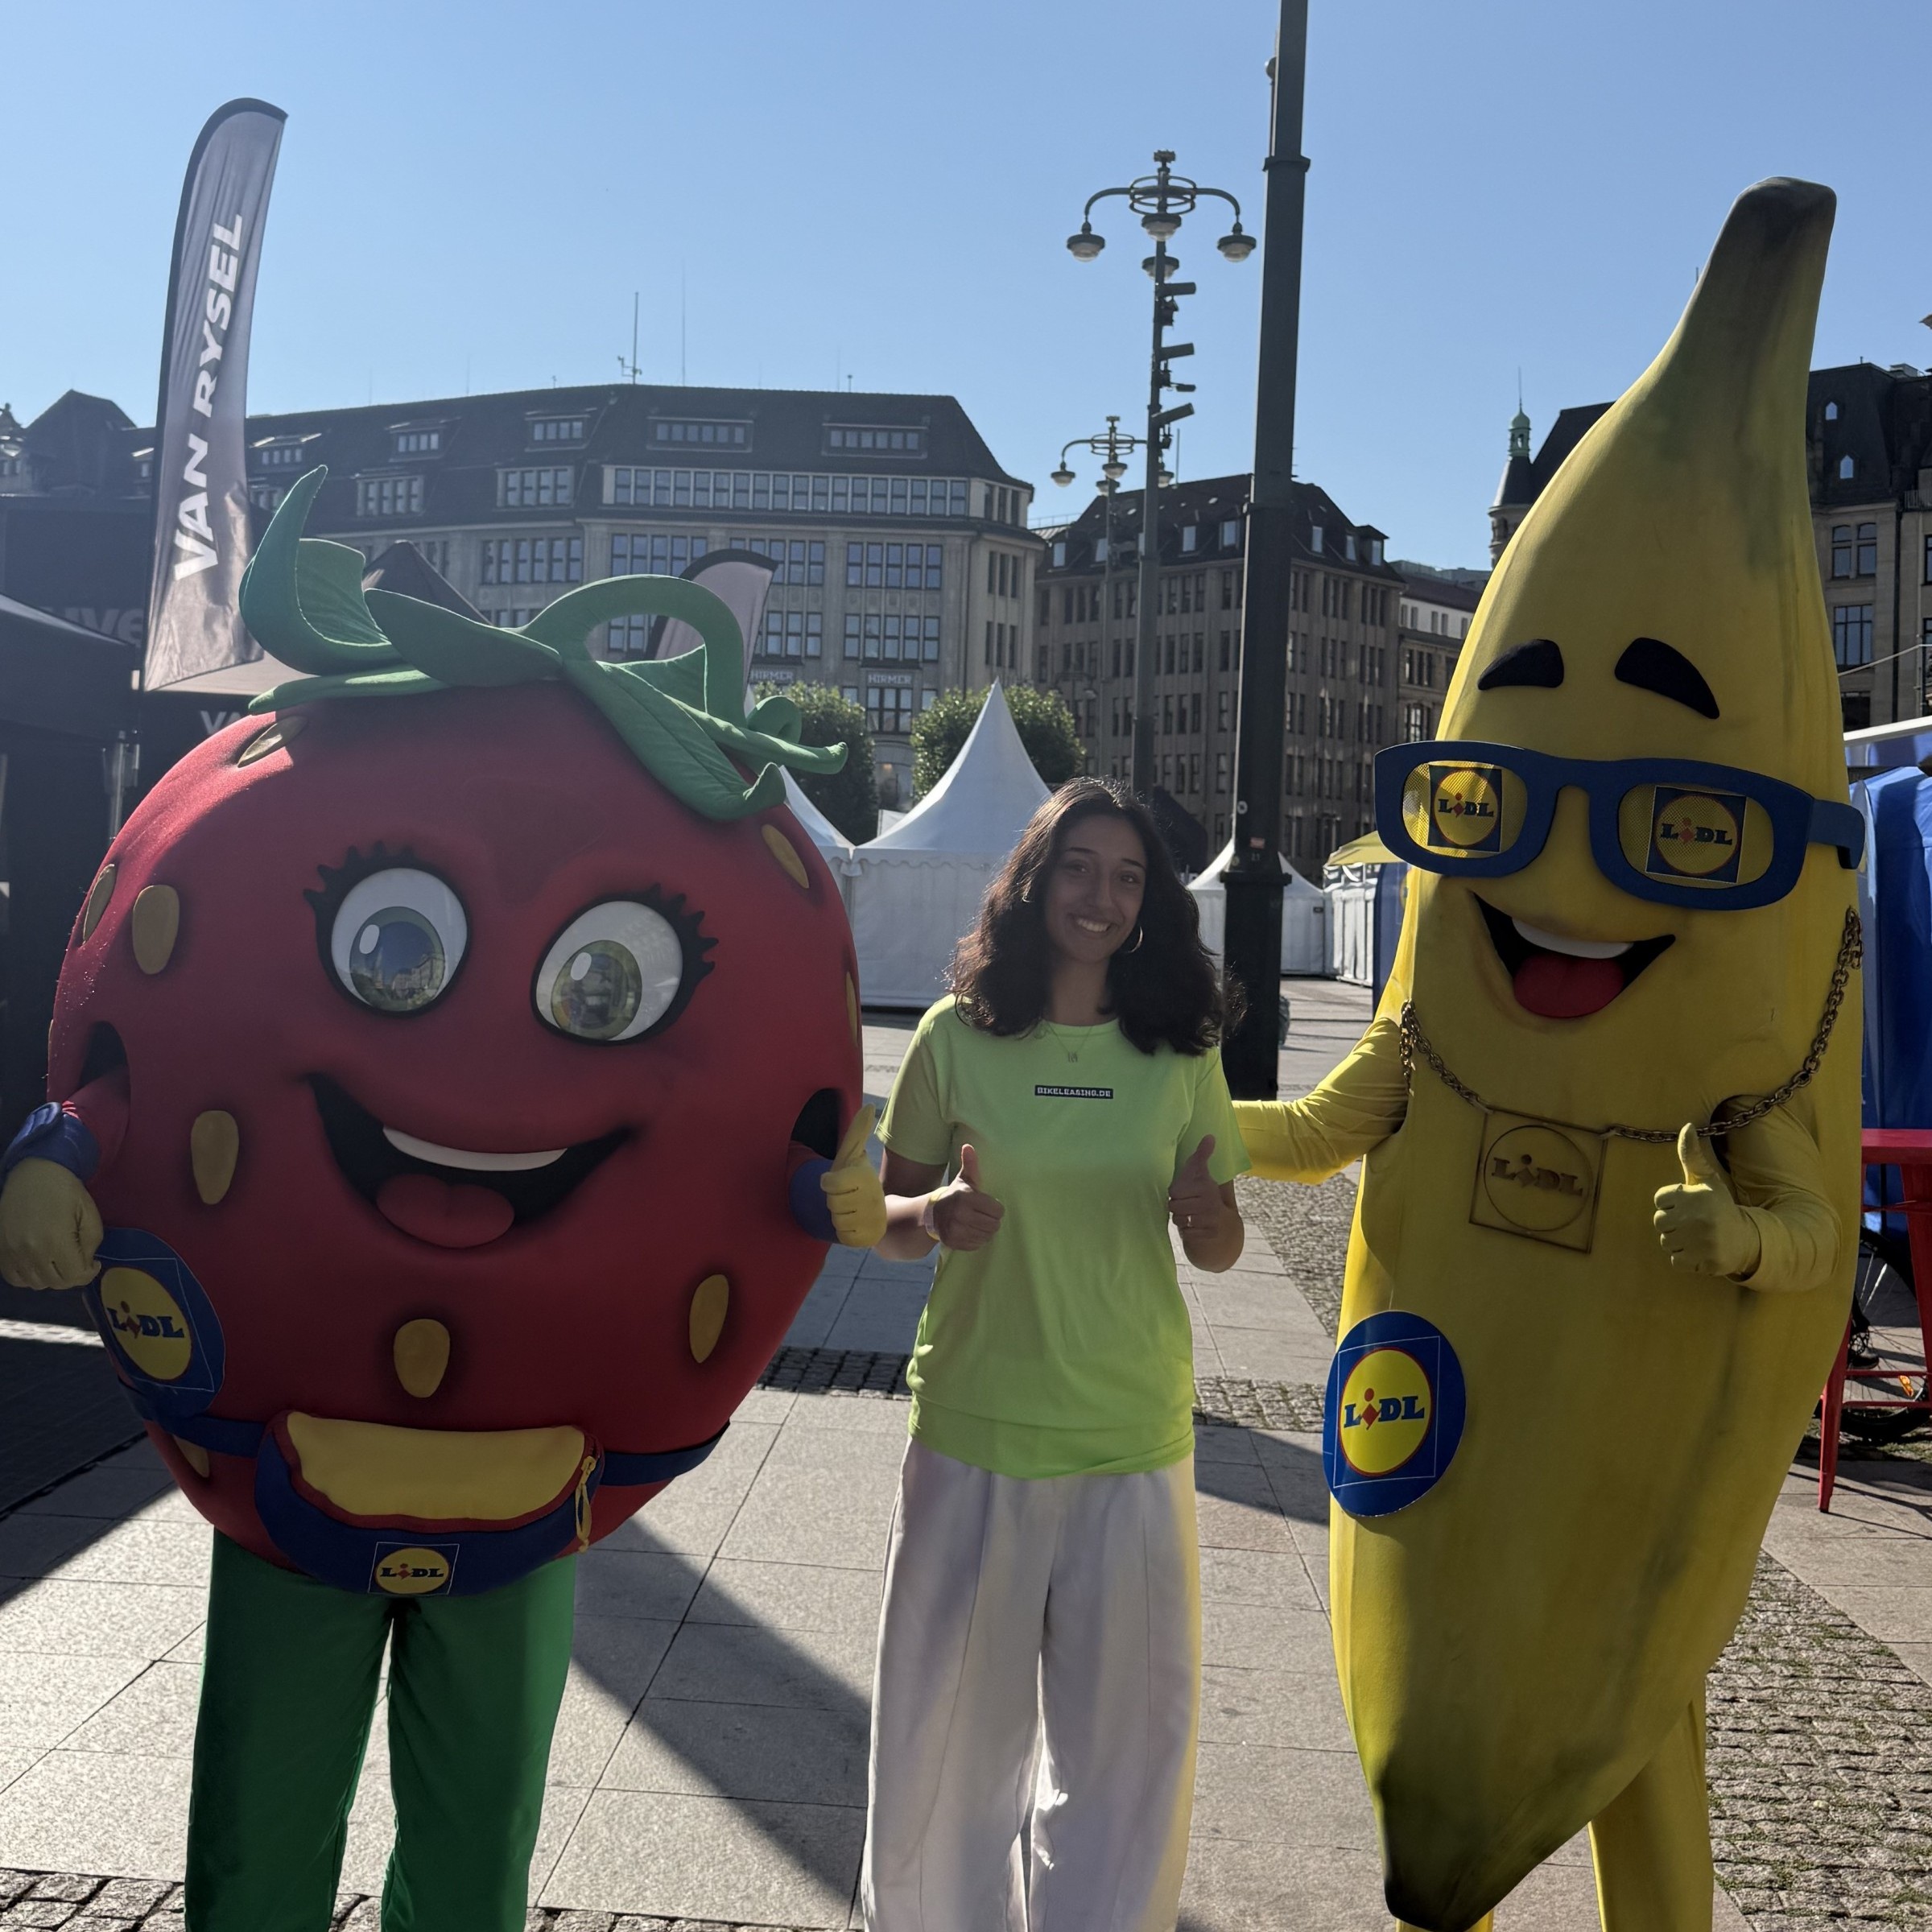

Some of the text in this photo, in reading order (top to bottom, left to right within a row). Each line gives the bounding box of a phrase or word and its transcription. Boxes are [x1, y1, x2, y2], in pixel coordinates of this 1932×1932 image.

[174, 213, 243, 581] VAN RYSEL
[750, 669, 794, 683] HIRMER
[868, 673, 912, 684] HIRMER
[1037, 1086, 1111, 1097] BIKELEASING.DE
